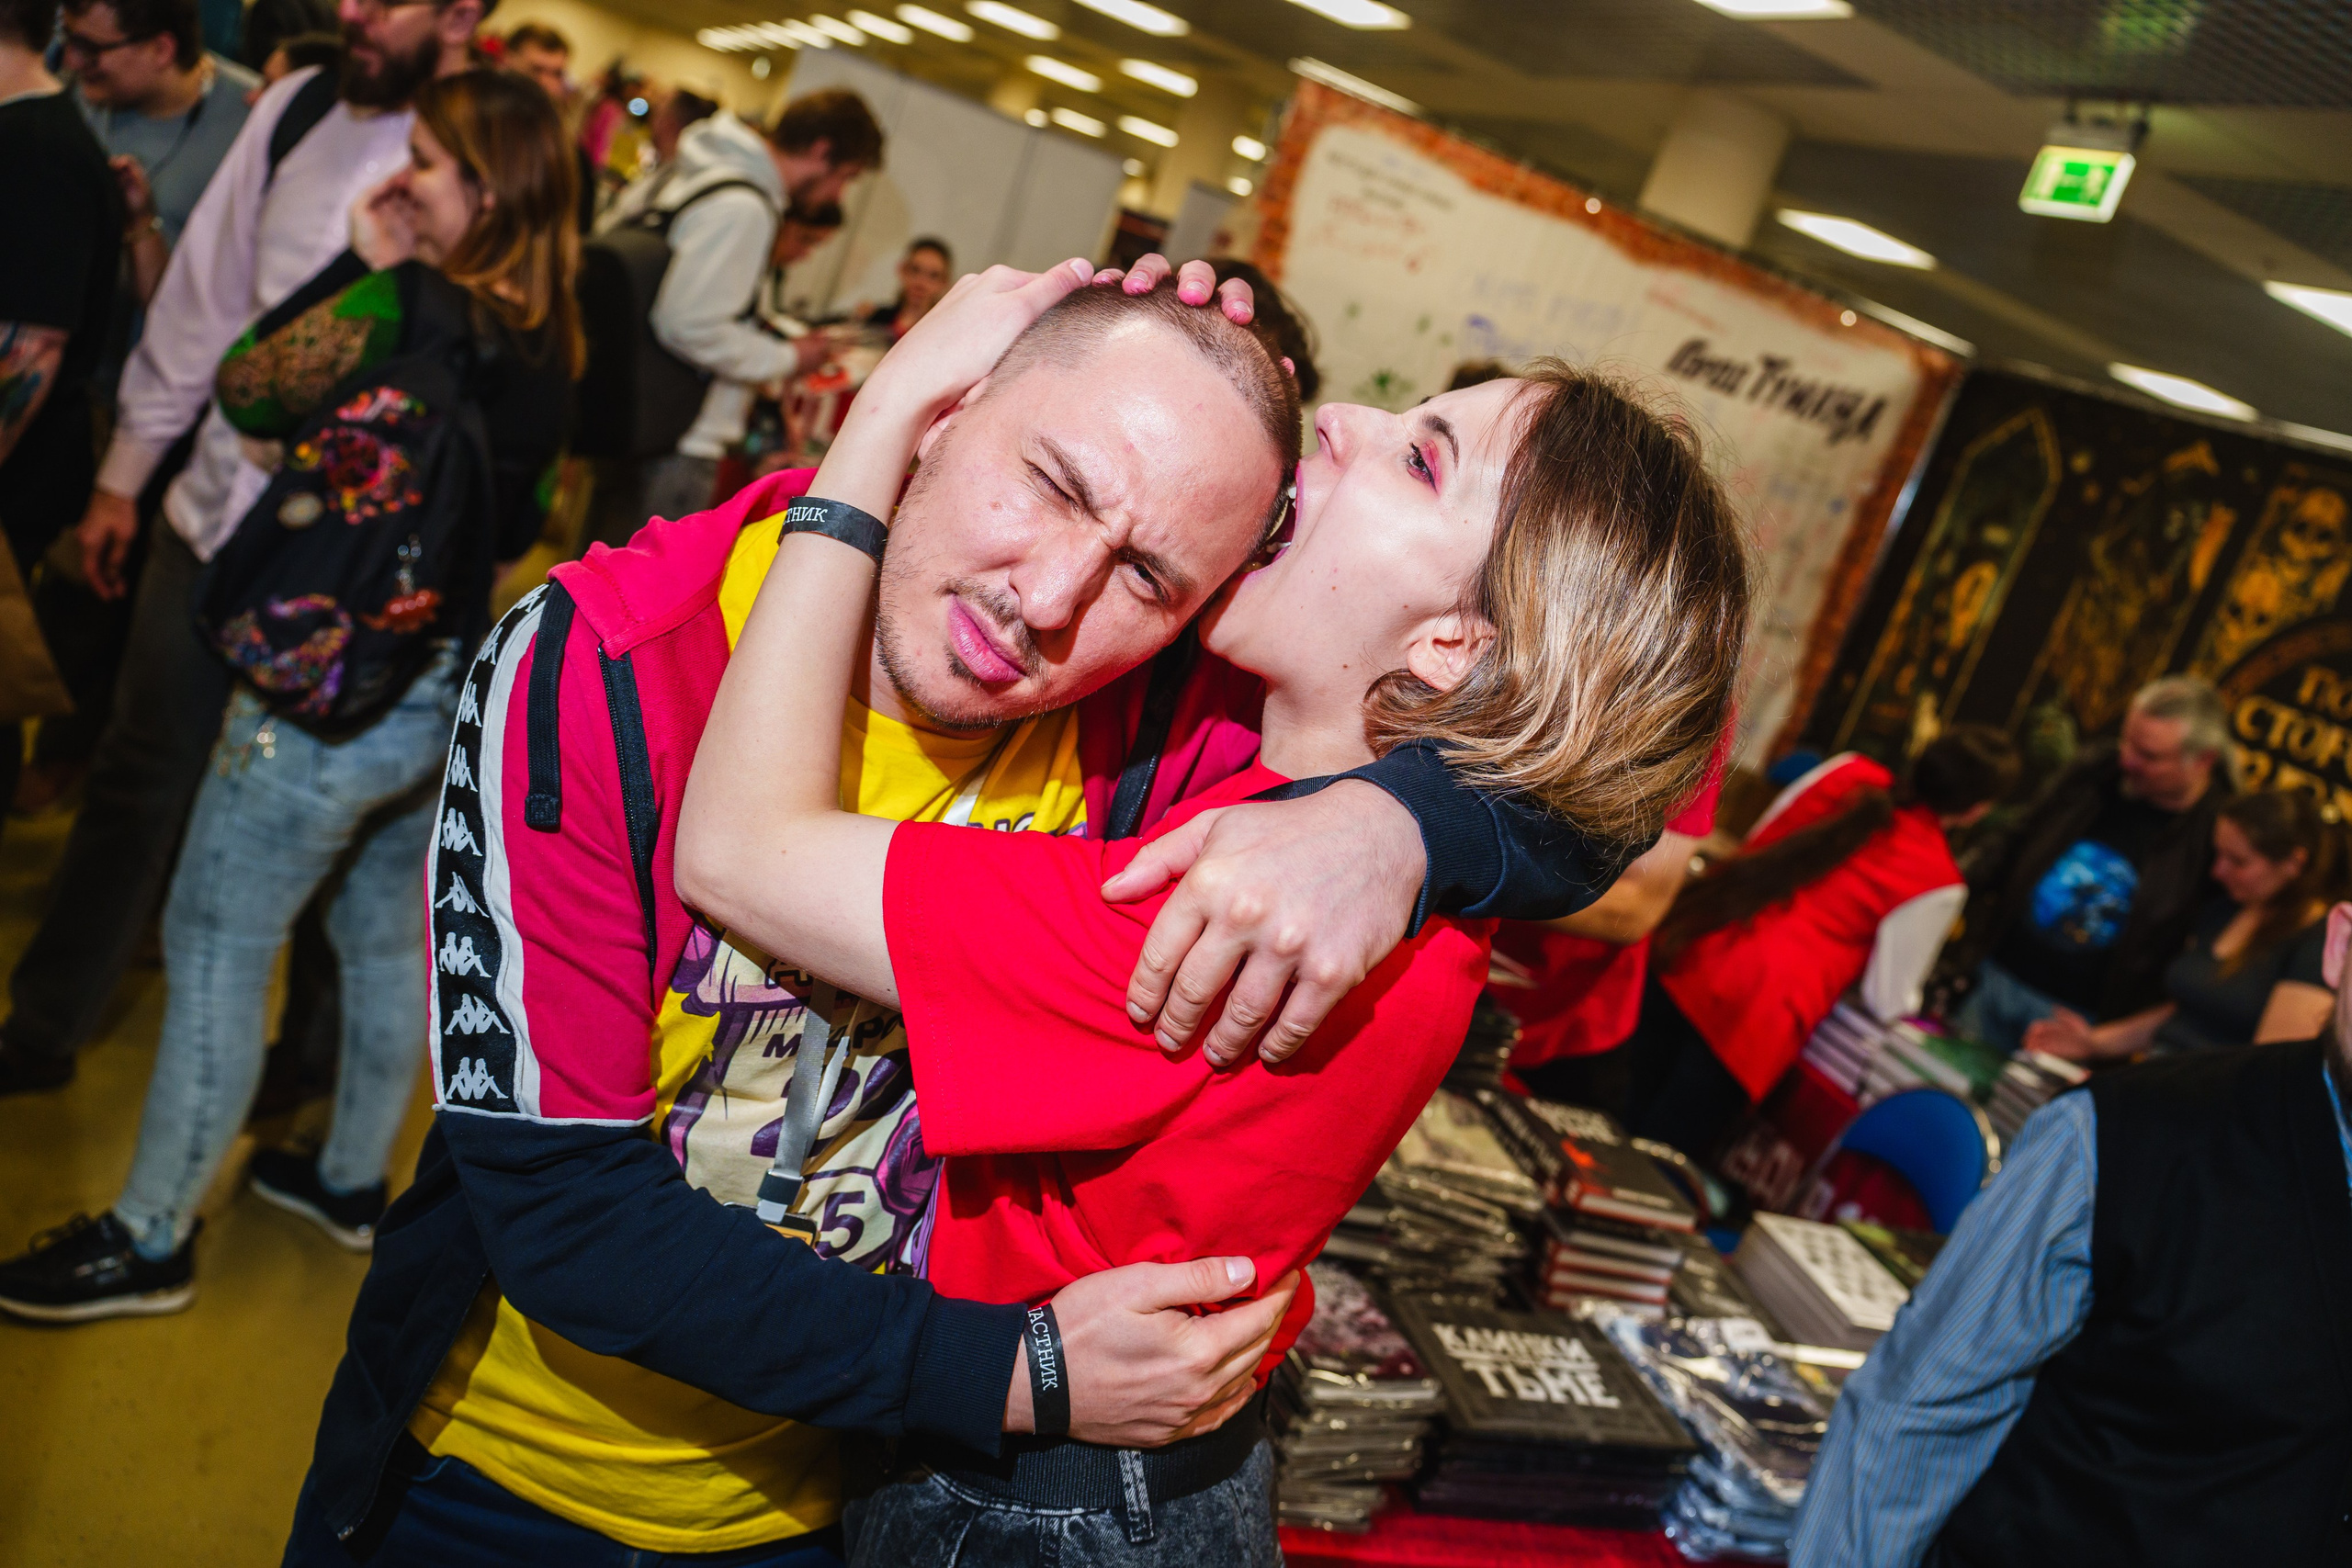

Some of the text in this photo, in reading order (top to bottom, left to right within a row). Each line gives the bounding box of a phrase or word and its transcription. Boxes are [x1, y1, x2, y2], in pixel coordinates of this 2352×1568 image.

[783, 506, 829, 525] ТНИК
[2234, 694, 2352, 779] СТОР
[1462, 1360, 1623, 1409] ТЬМЕ
